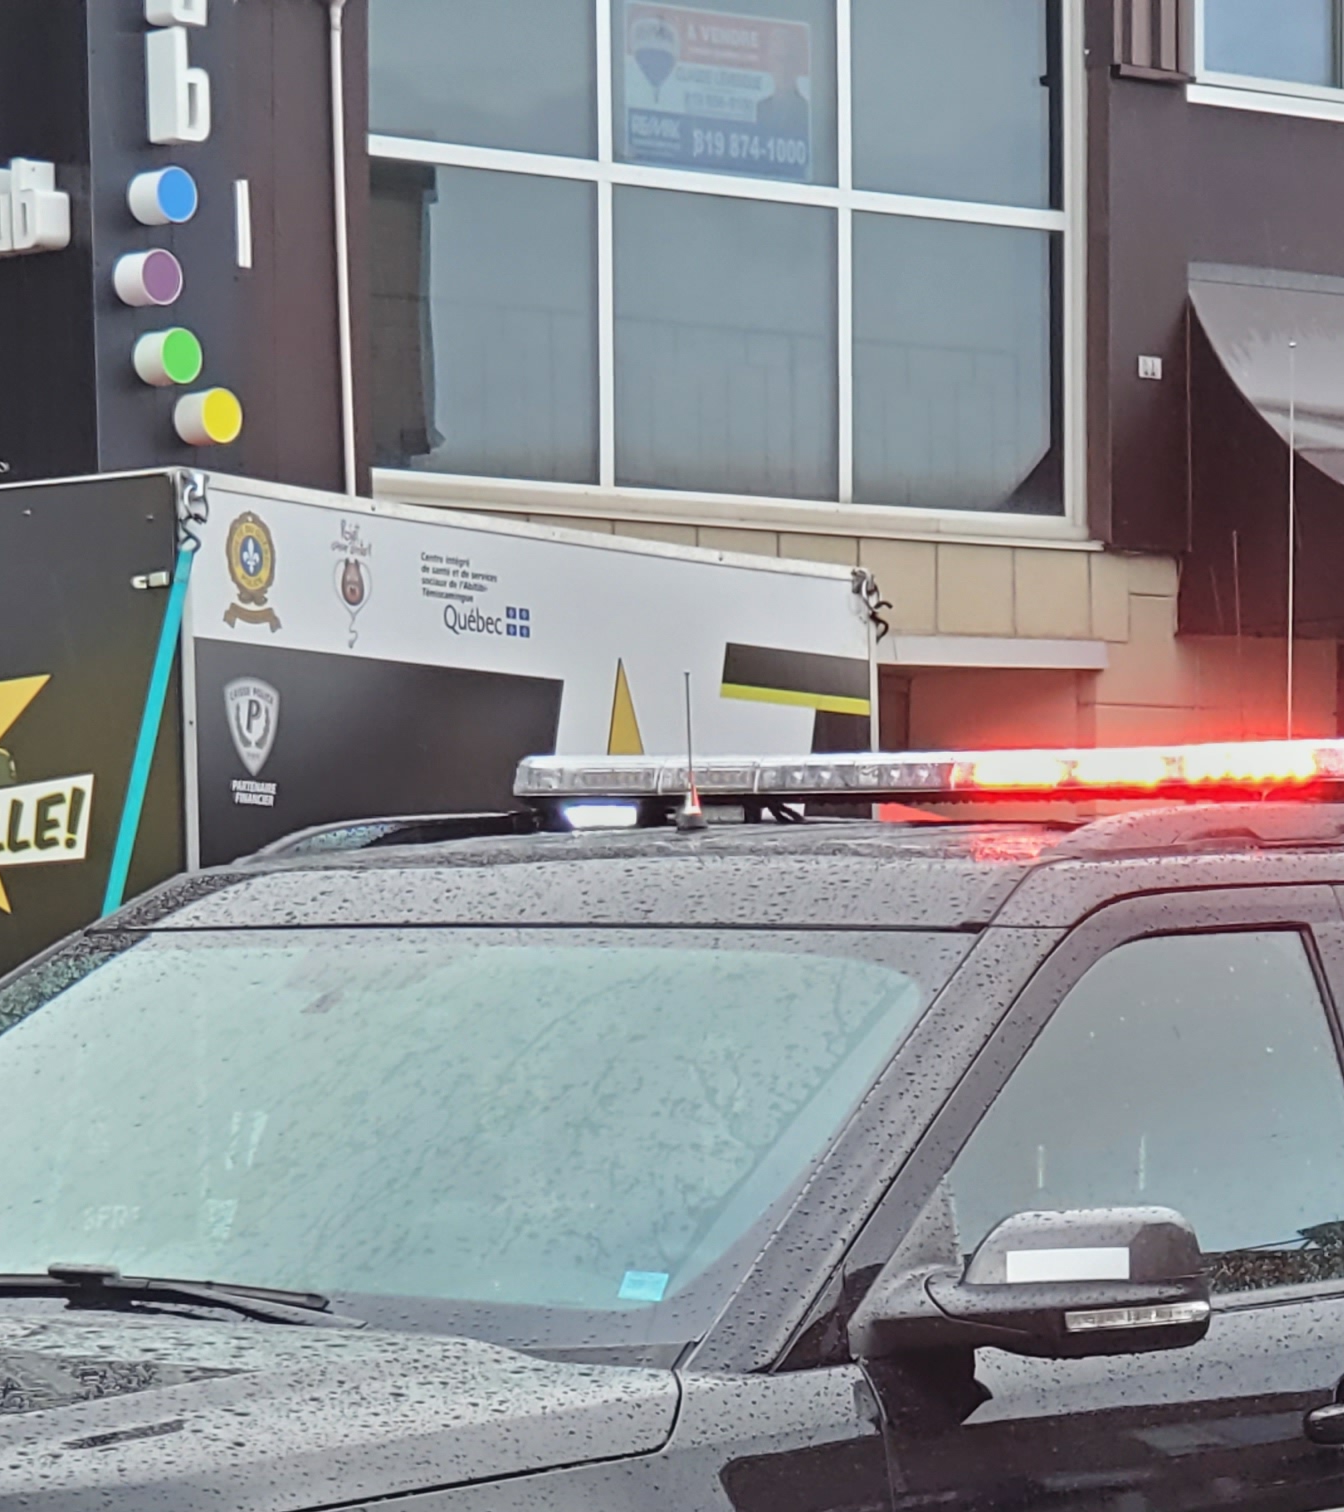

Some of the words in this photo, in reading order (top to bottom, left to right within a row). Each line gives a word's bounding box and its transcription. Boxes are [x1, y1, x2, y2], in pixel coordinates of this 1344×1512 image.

[702, 25, 759, 48] VENDRE
[729, 132, 807, 165] 874-1000
[420, 552, 444, 564] Centre
[421, 565, 430, 574] de
[432, 566, 451, 577] santé
[452, 569, 460, 578] et
[461, 570, 469, 579] de
[471, 572, 498, 583] services
[421, 577, 447, 588] sociaux
[448, 580, 457, 589] de
[443, 604, 503, 636] Québec
[231, 779, 278, 796] PARTENAIRE
[234, 791, 275, 807] FINANCIER
